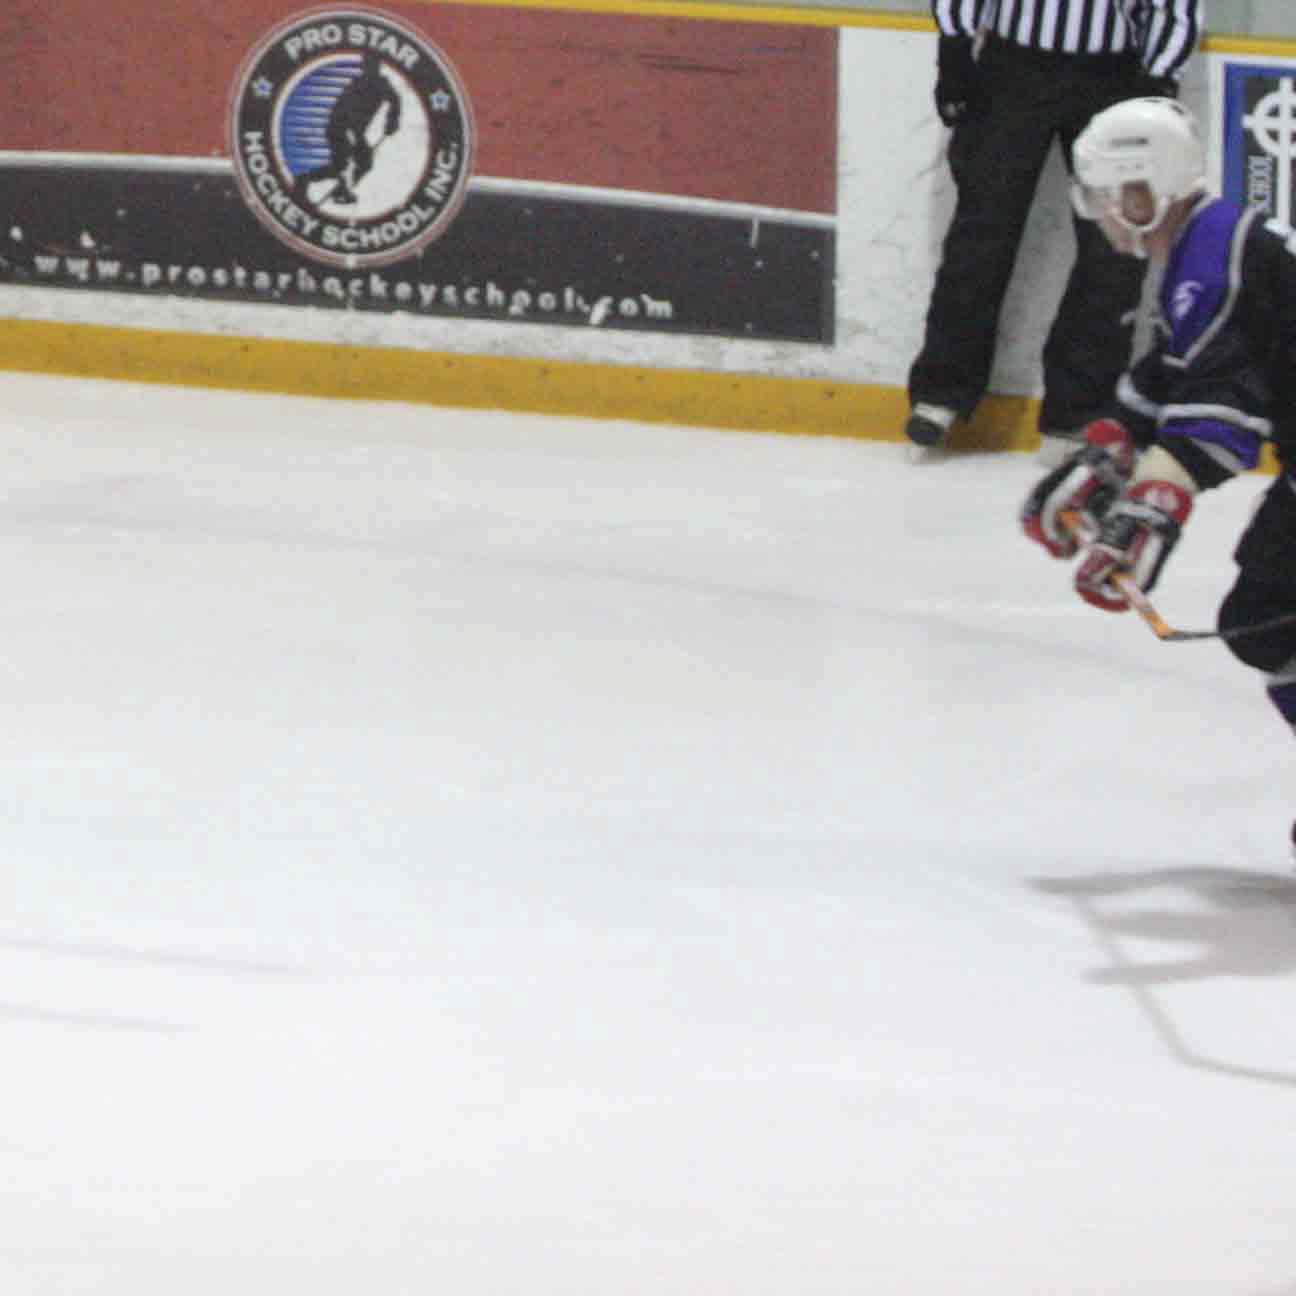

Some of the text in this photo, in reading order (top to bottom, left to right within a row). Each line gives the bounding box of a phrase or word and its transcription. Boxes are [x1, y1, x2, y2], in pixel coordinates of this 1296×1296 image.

[284, 23, 420, 69] PRO STAR
[244, 130, 459, 249] HOCKEY SCHOOL INC.
